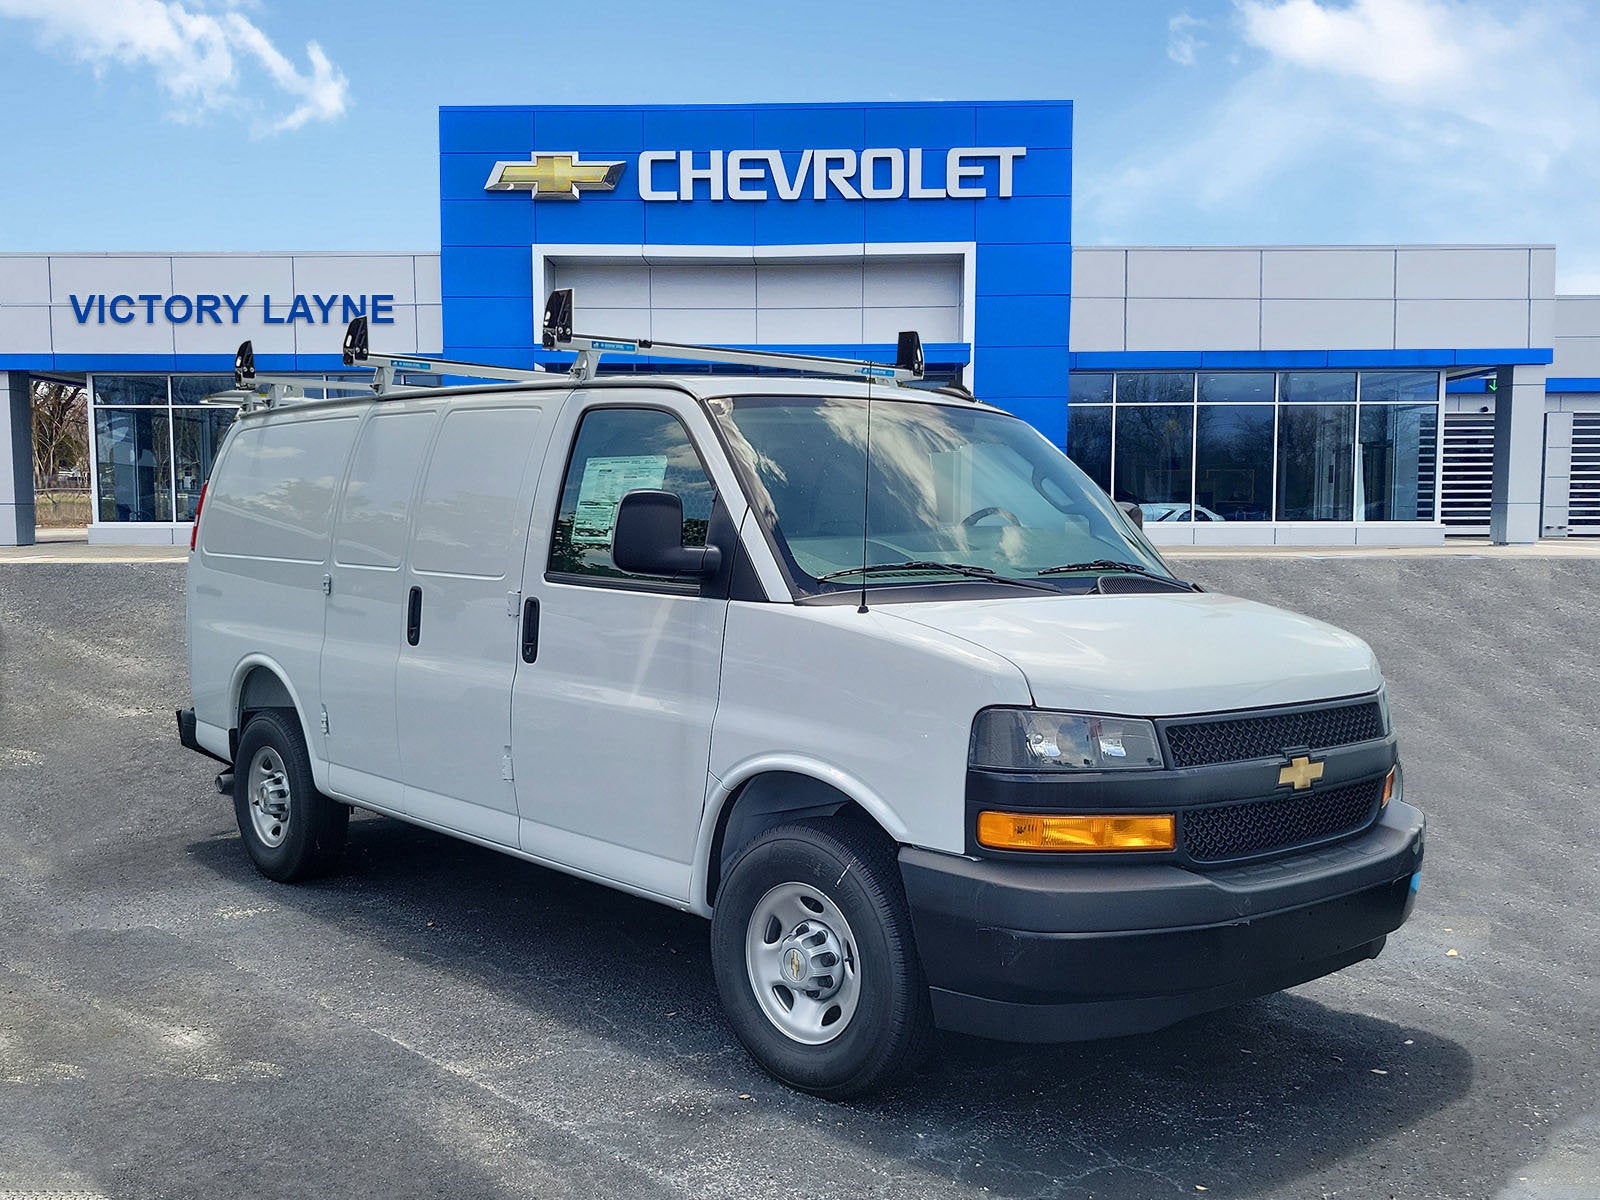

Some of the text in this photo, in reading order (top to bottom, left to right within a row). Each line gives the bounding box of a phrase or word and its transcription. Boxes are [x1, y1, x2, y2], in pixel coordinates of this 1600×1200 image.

[638, 147, 1027, 202] CHEVROLET
[70, 293, 395, 325] VICTORY LAYNE
